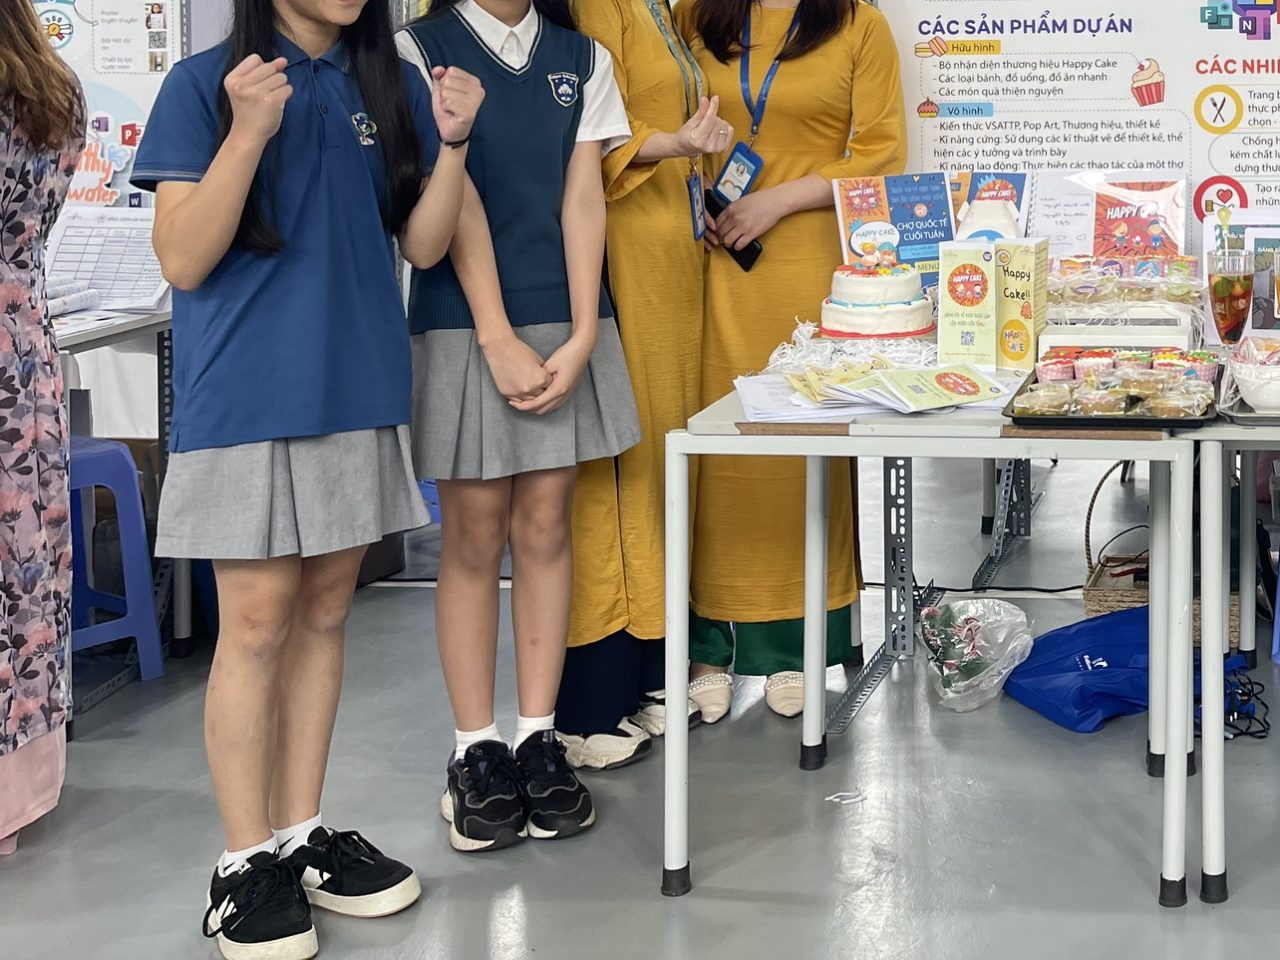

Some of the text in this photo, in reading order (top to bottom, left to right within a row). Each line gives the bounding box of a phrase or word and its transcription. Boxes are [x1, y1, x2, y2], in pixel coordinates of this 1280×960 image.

[1204, 10, 1212, 20] F
[918, 10, 1133, 37] CÁC SẢN PHẨM DỰ ÁN
[1242, 20, 1252, 30] N
[952, 42, 995, 53] Hữu hình
[1195, 54, 1237, 74] CÁC
[947, 105, 983, 116] Vô hình
[1234, 162, 1259, 174] dựng
[1003, 266, 1031, 281] Happy
